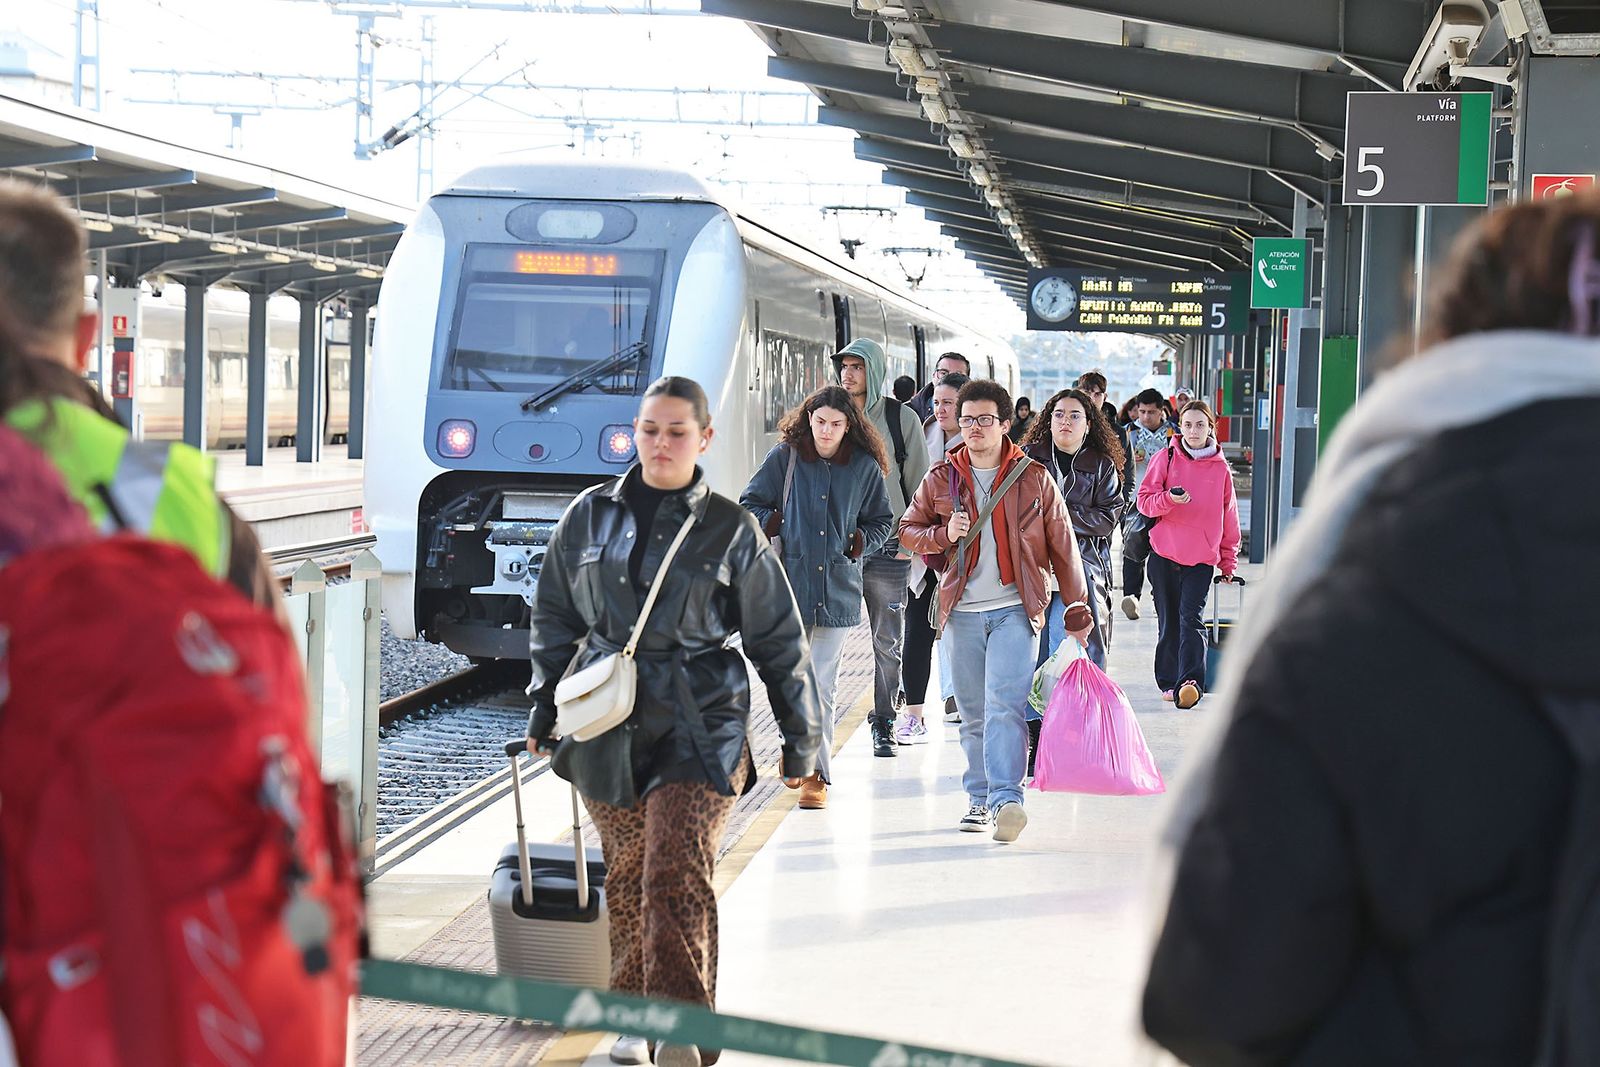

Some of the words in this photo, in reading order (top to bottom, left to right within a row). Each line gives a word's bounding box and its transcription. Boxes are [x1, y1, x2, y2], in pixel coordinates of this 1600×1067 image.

[1438, 97, 1457, 110] Vía
[1416, 114, 1457, 122] PLATFORM
[1355, 146, 1385, 197] 5
[1211, 302, 1226, 329] 5
